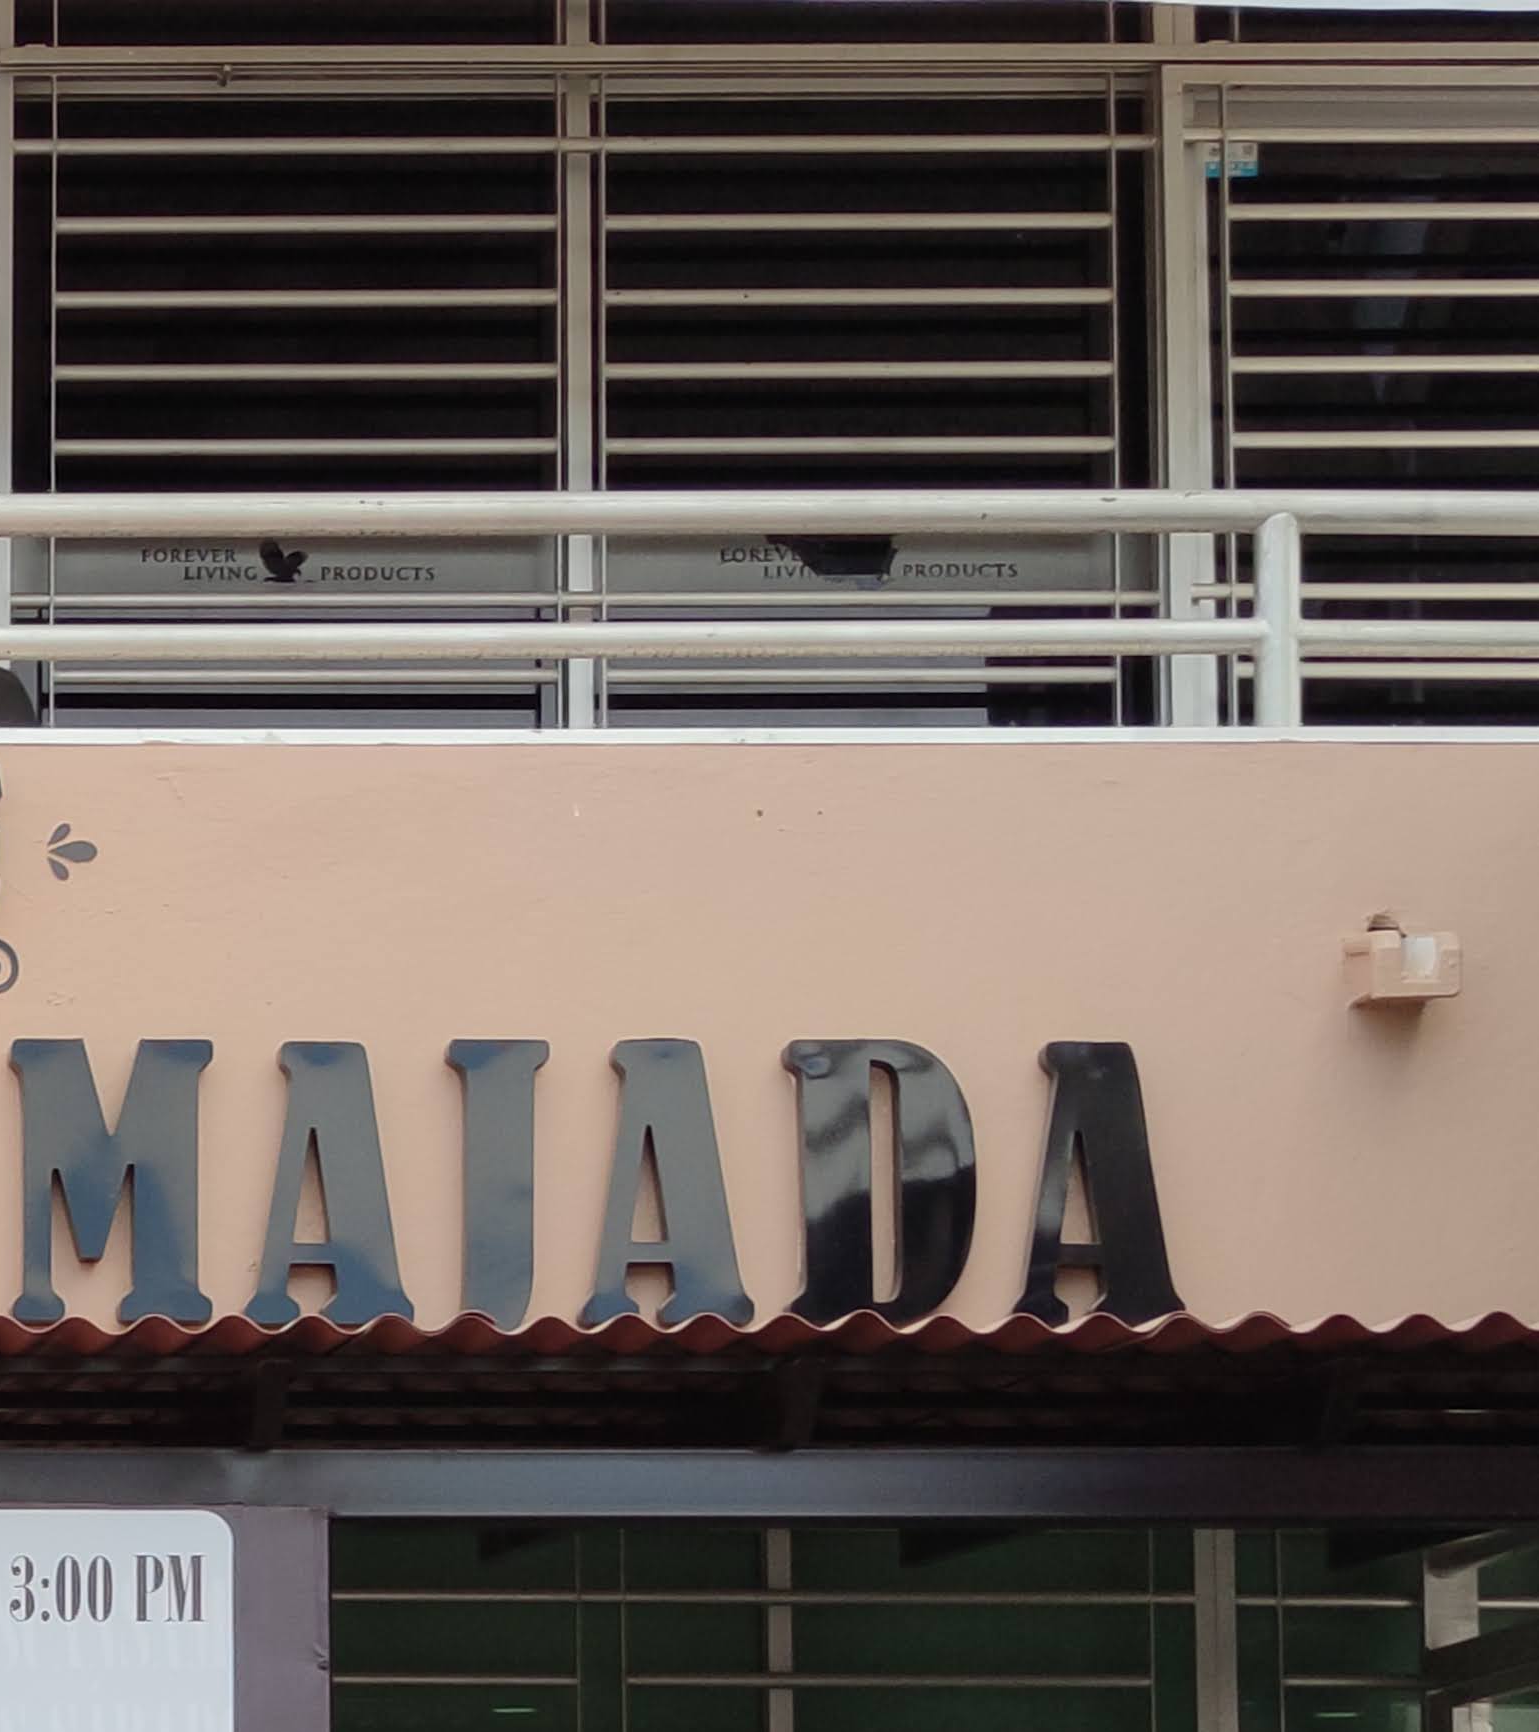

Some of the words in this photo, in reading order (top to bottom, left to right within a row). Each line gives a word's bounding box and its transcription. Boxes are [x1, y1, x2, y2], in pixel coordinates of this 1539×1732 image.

[141, 548, 237, 563] FOREVER
[183, 566, 258, 581] LIVING
[321, 566, 436, 581] PRODUCTS
[903, 563, 1018, 578] PRODUCTS
[9, 1038, 1188, 1332] MAJADA
[9, 1555, 113, 1622] 3:00
[136, 1554, 204, 1622] PM
